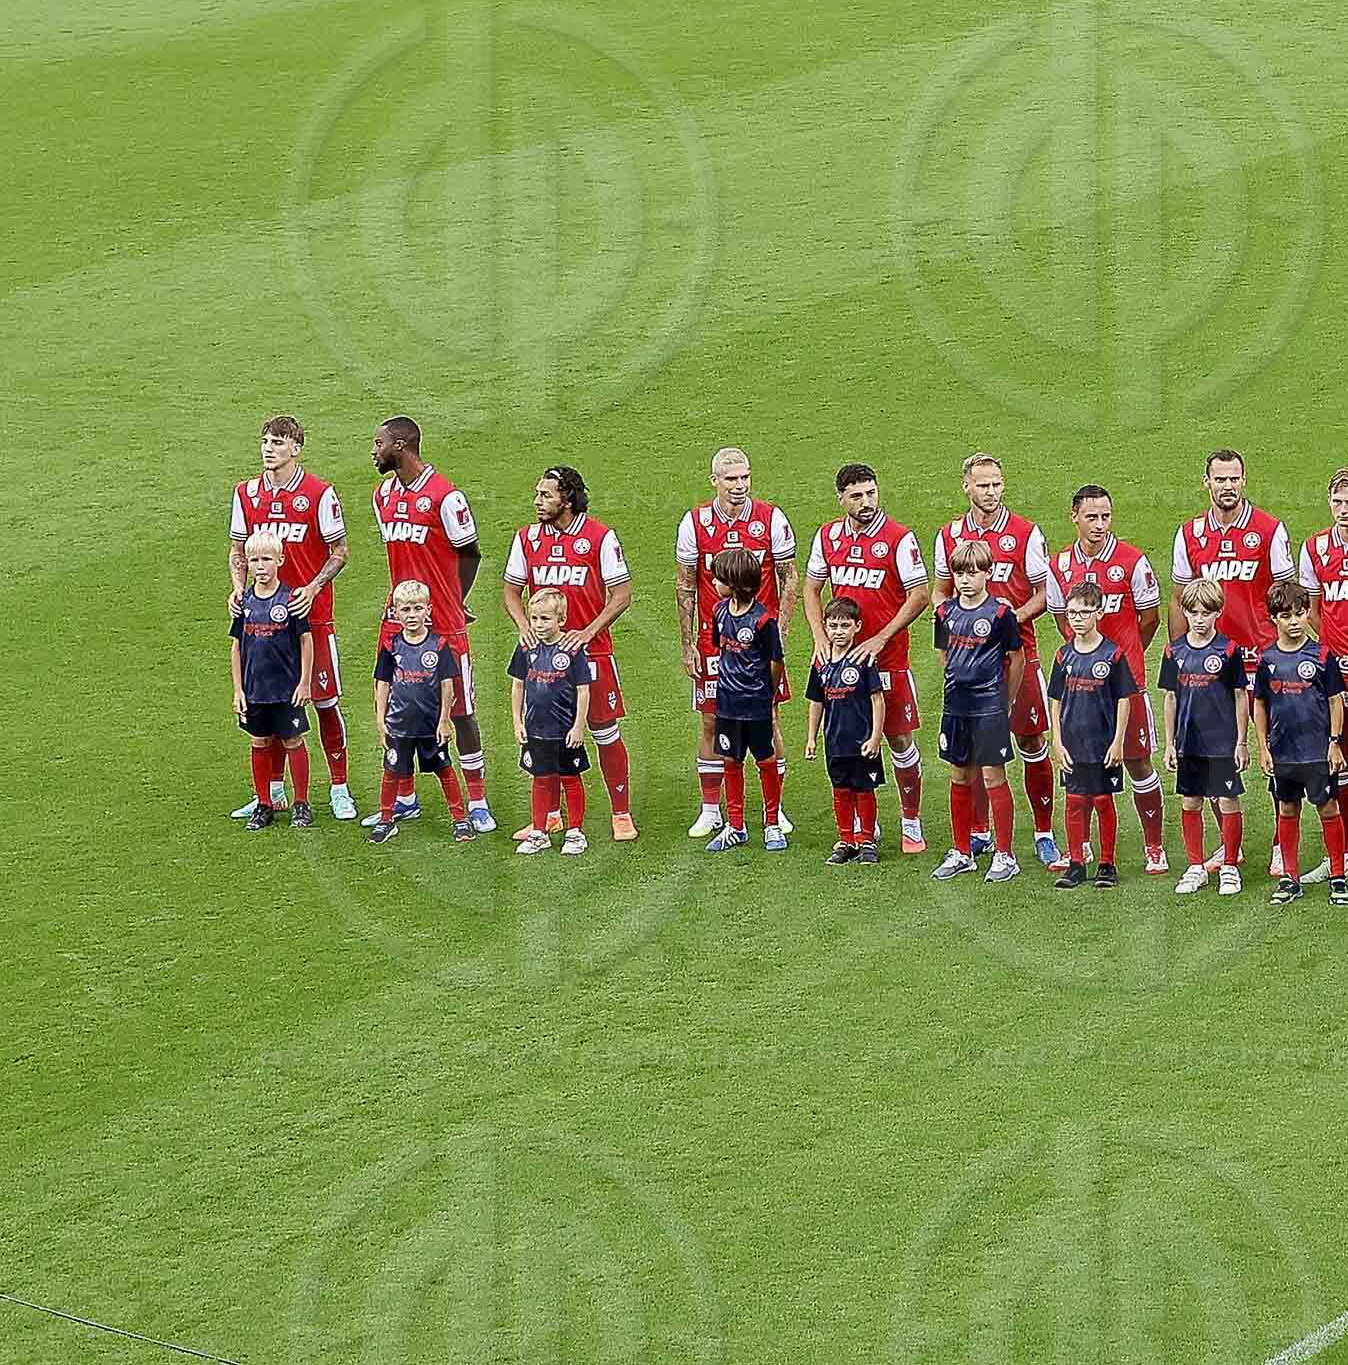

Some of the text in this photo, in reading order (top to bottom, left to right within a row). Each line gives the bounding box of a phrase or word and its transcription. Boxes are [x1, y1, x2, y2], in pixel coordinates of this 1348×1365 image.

[382, 522, 430, 544] MAPEI
[531, 565, 588, 587] MAPEI
[830, 565, 886, 589] MAPEI
[1200, 560, 1259, 581] MAPEI
